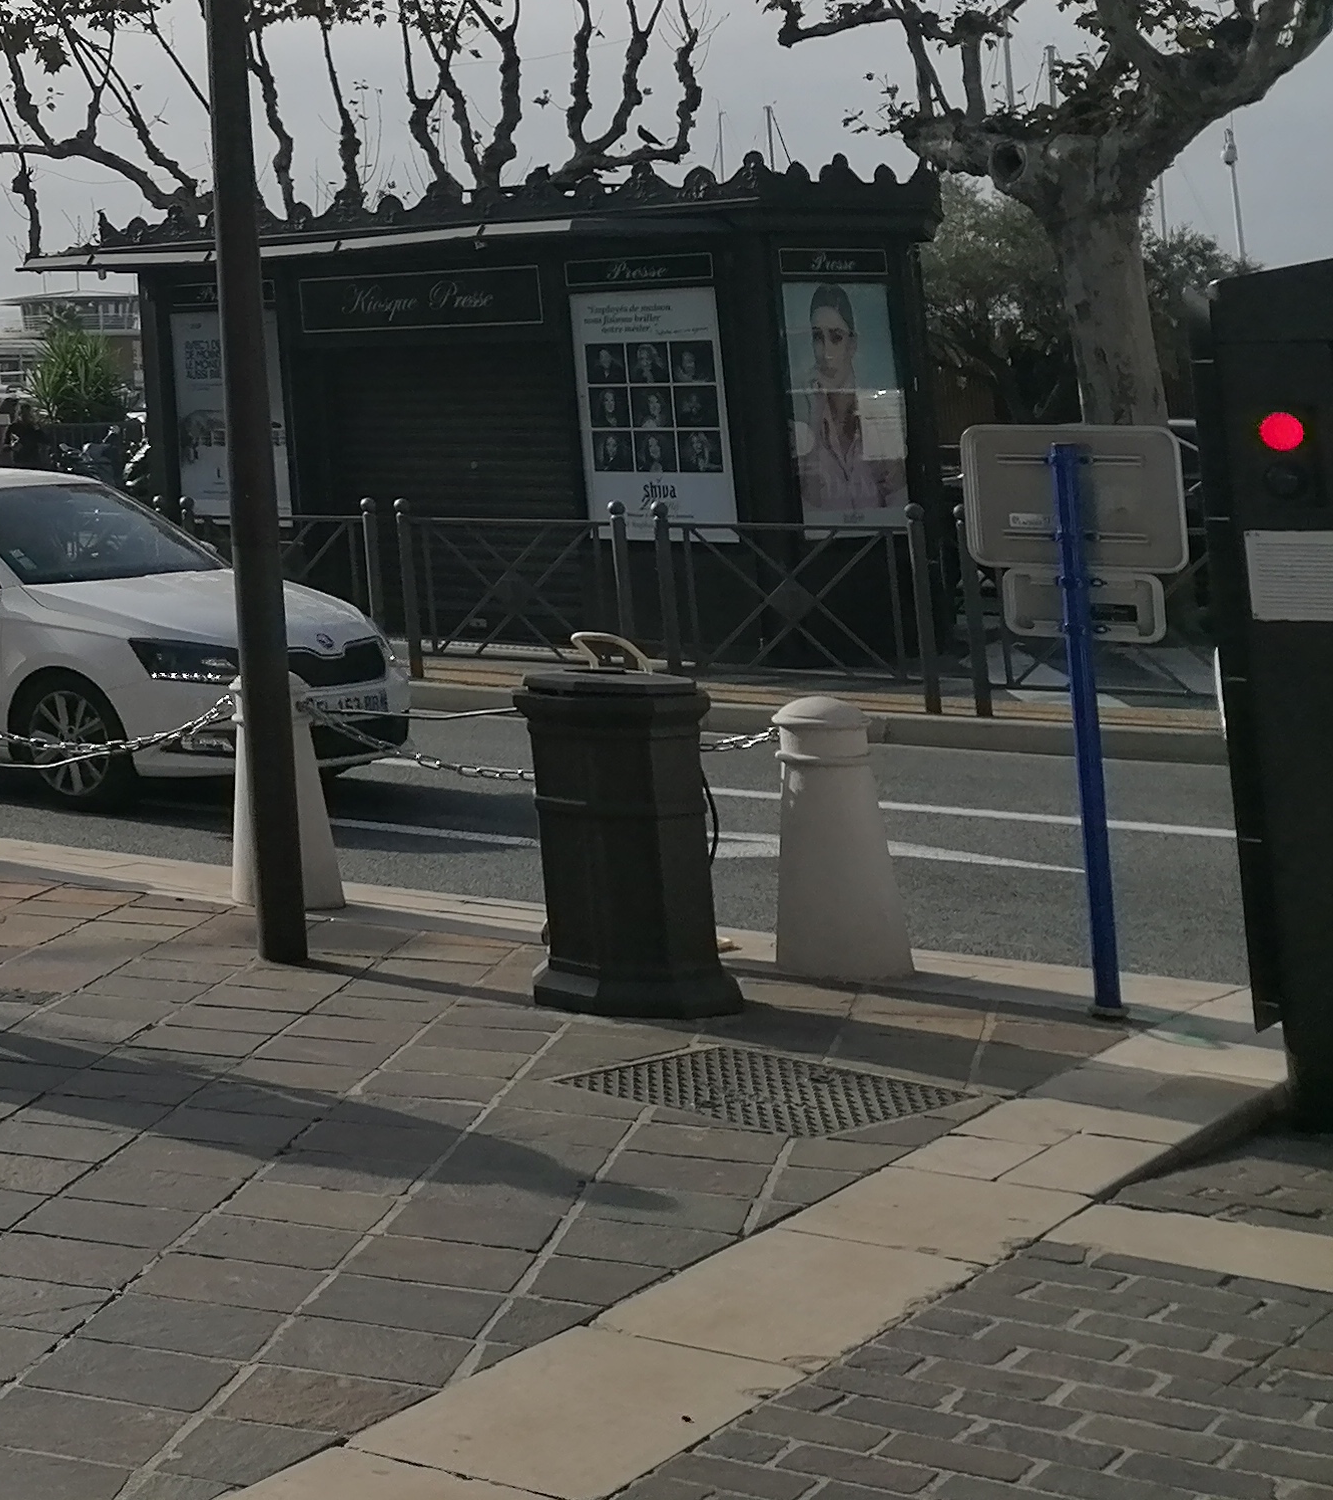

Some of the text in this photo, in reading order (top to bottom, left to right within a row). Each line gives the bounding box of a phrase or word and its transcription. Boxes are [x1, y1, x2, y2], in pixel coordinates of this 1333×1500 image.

[607, 260, 668, 280] Presse
[811, 252, 857, 271] Presse
[342, 280, 494, 321] Kiosque Presse
[643, 480, 677, 499] shiva
